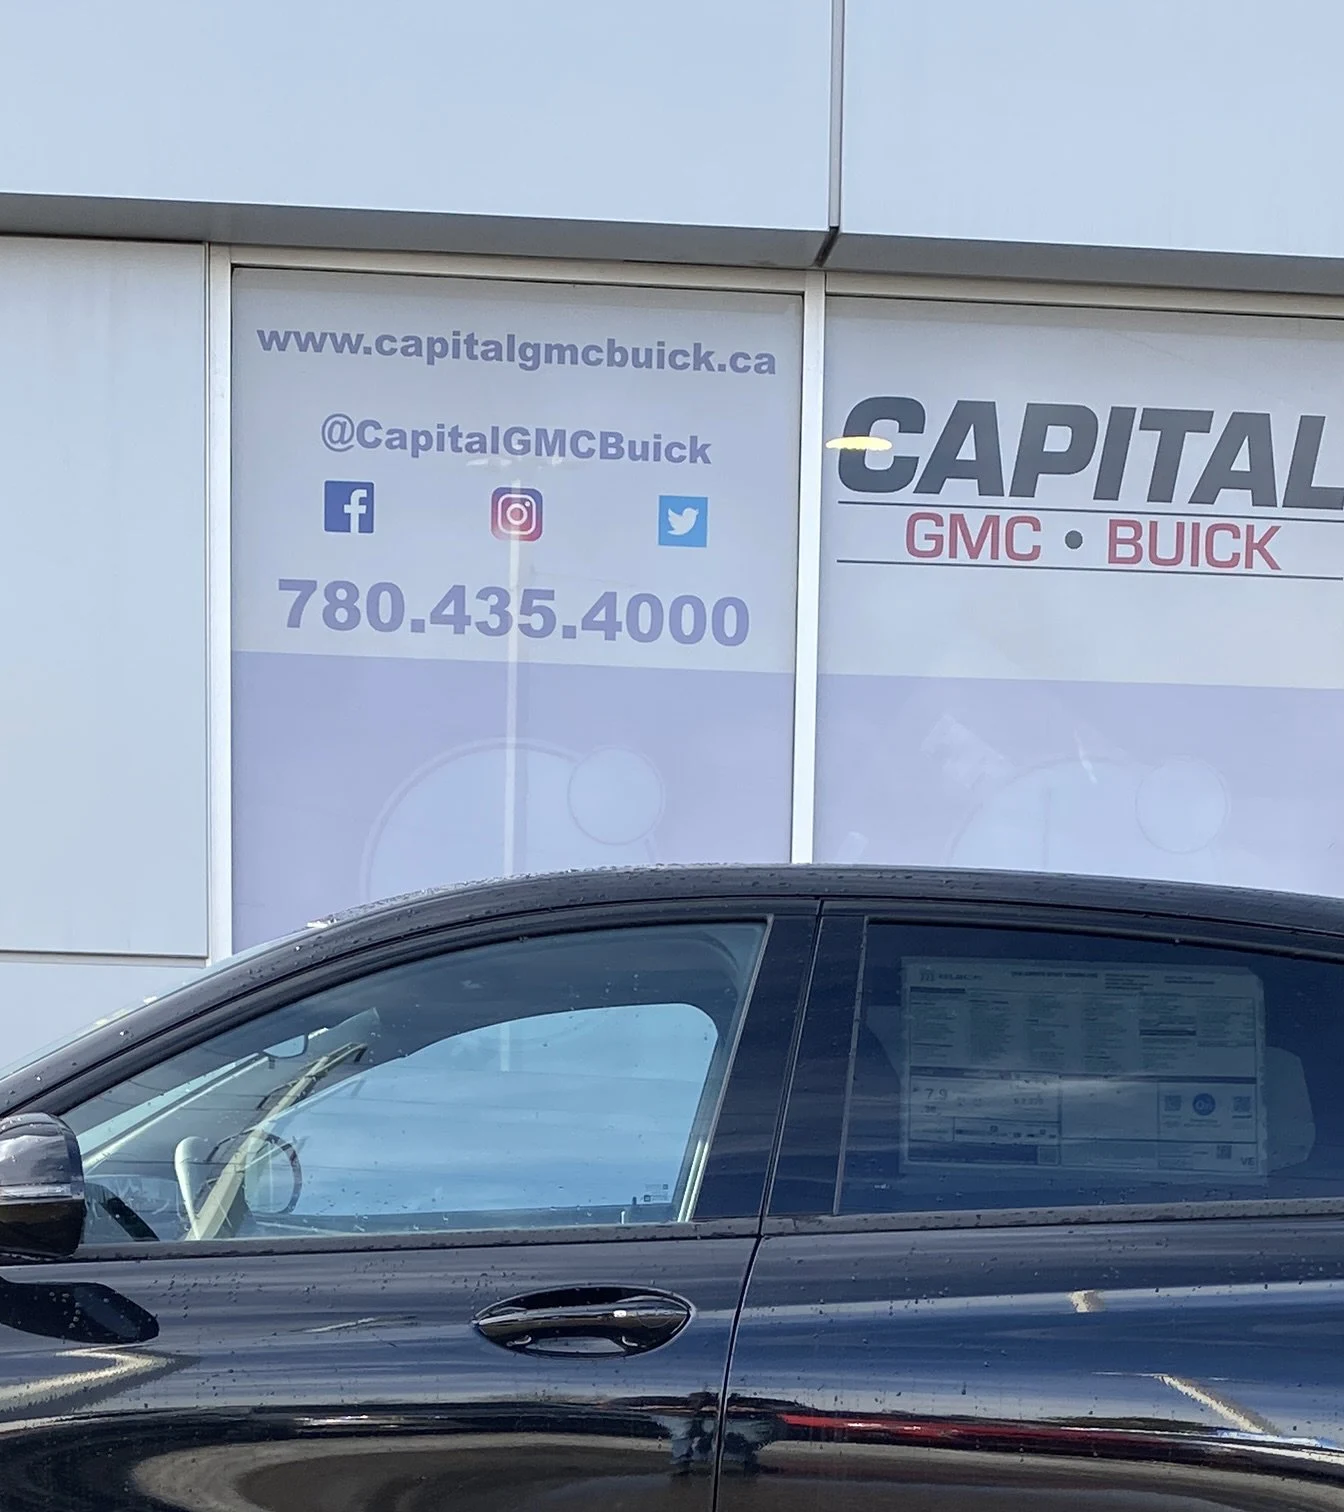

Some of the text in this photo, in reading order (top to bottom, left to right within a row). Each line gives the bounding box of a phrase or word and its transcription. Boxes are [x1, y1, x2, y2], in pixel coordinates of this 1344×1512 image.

[257, 328, 777, 376] www.capitalgmcbuick.ca
[321, 413, 712, 465] @CapitalGMCBuick
[905, 512, 1281, 571] GMC BUICK
[278, 578, 750, 647] 780.435.4000
